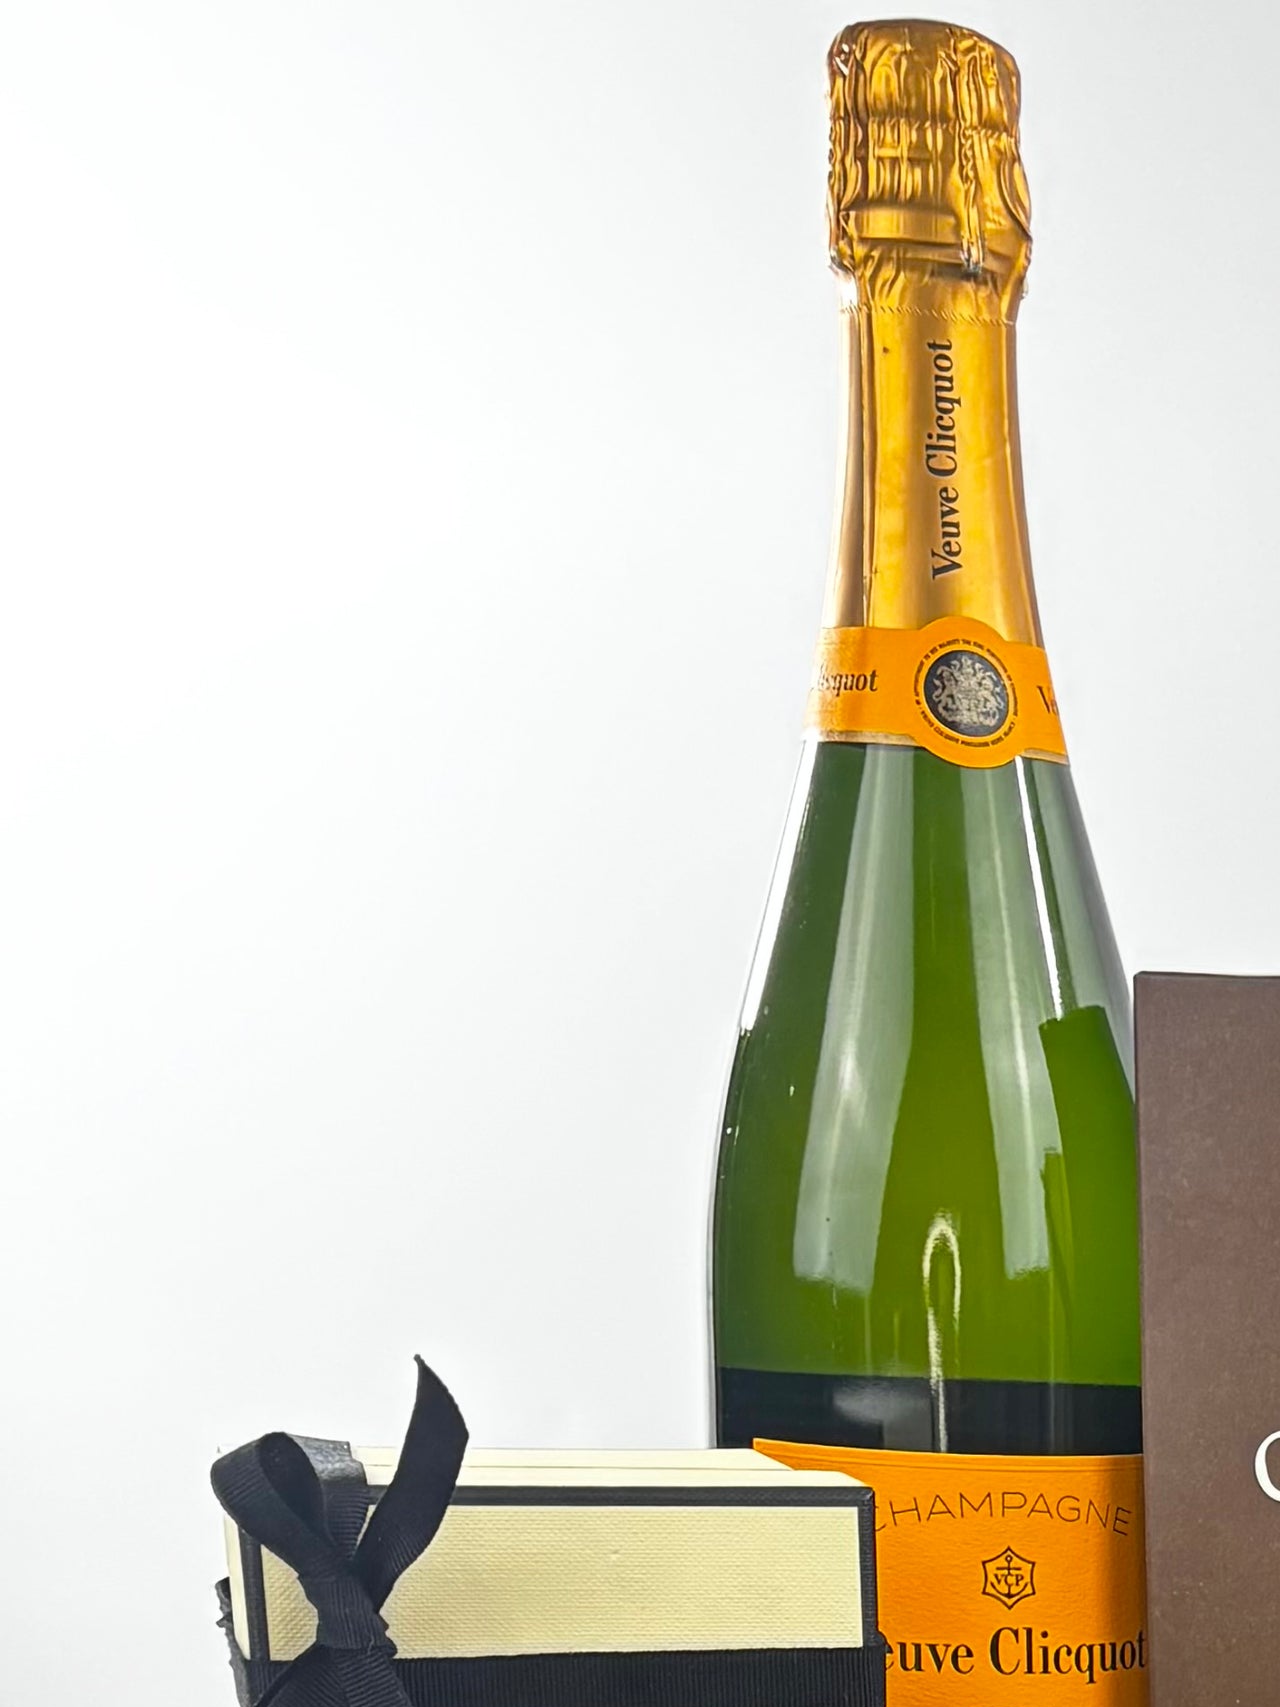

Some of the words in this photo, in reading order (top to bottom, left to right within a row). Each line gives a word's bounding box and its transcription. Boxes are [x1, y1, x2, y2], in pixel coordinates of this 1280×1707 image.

[925, 338, 961, 478] Clicquot
[931, 487, 963, 580] Veuve
[874, 1491, 1132, 1537] HAMPAGNE
[989, 1626, 1146, 1685] Clicquot
